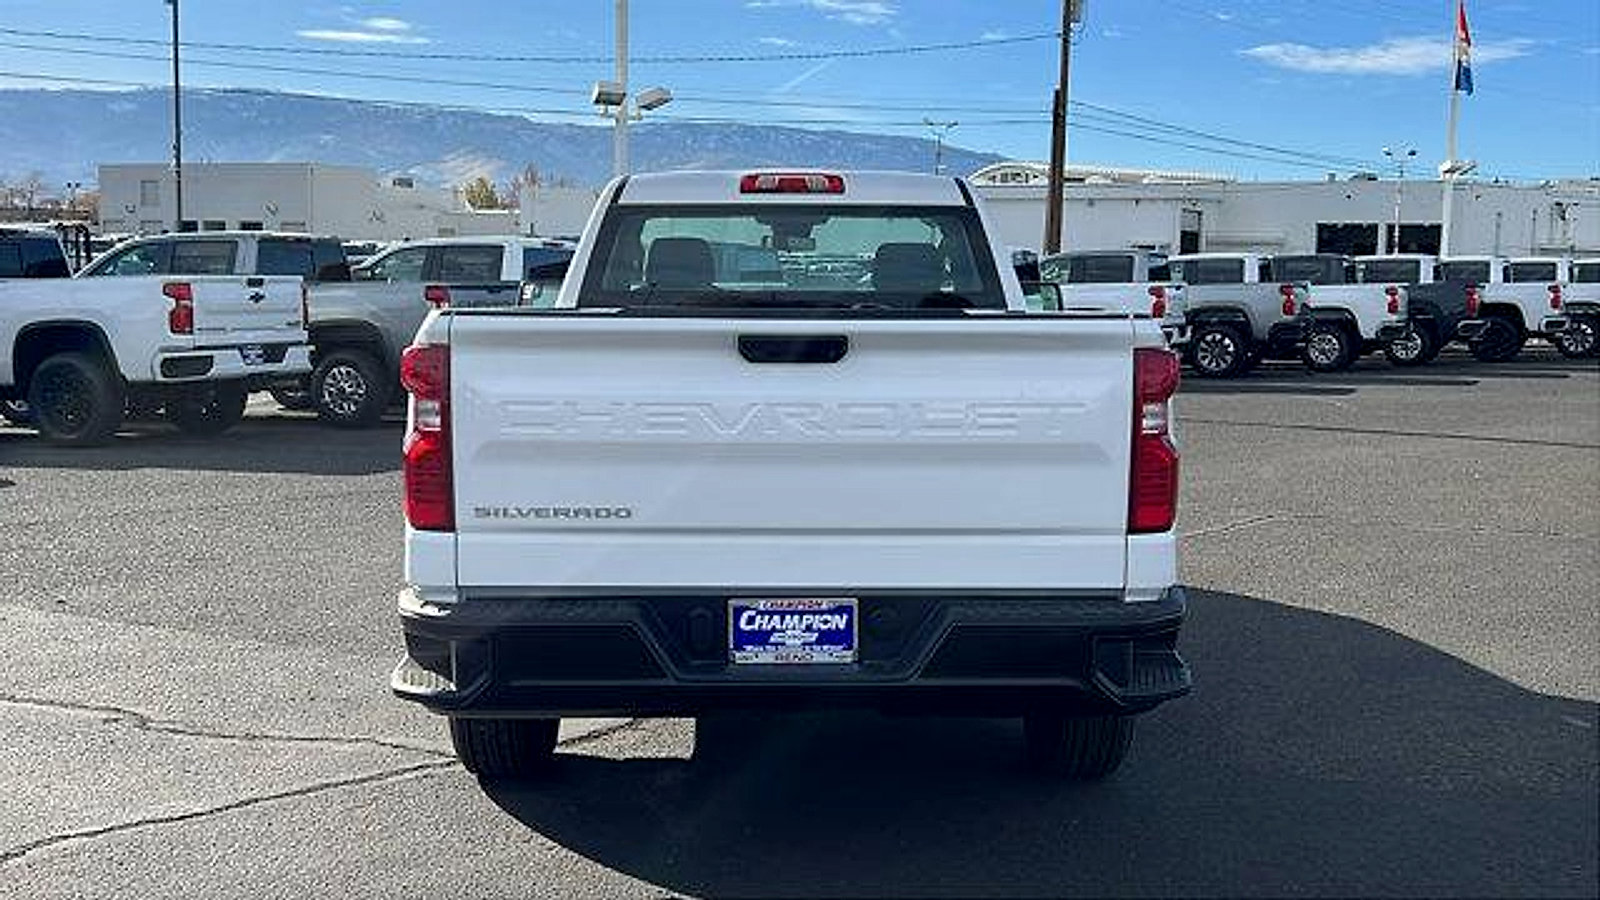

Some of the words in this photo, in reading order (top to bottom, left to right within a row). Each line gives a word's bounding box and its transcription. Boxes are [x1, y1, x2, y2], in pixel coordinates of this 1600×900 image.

[499, 401, 1087, 437] CHEVROLET
[473, 506, 632, 519] SILVERADO
[739, 610, 849, 631] CHAMPION
